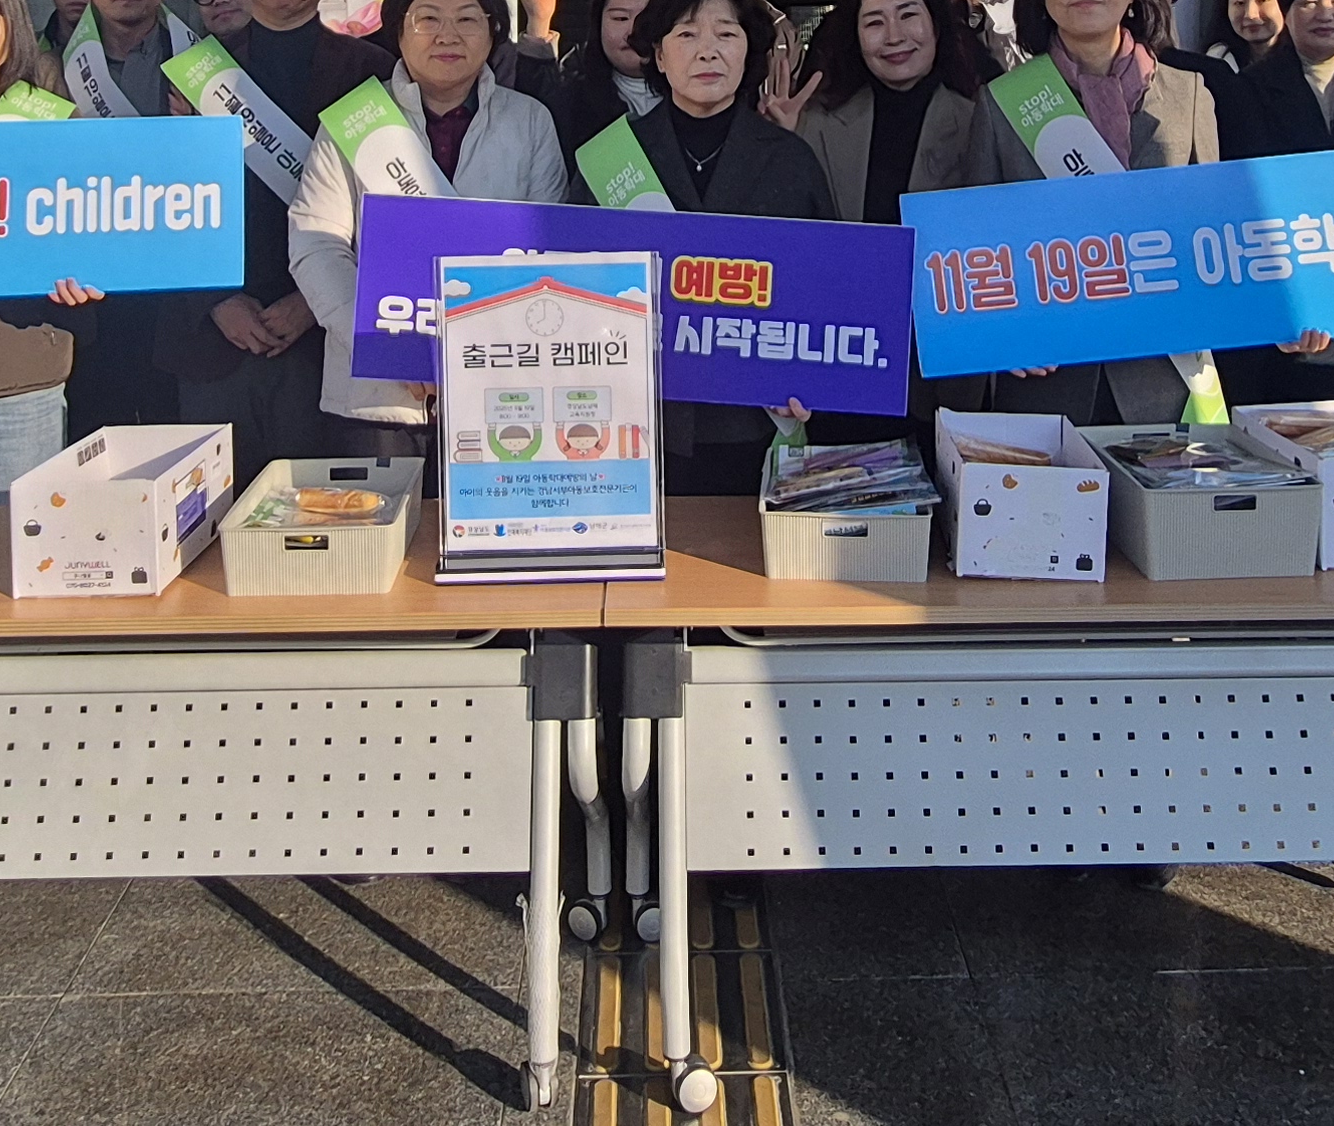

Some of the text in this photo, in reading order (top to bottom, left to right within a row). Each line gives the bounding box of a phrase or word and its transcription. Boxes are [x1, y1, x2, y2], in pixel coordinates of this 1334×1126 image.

[343, 100, 377, 128] stop!
[1018, 84, 1053, 115] stop!
[1021, 93, 1065, 127] 아동학대
[606, 161, 636, 194] stop!
[25, 175, 222, 236] children
[671, 255, 773, 307] 예방!
[925, 245, 1018, 314] 11월
[1027, 229, 1179, 305] 19일은
[462, 340, 629, 369] 출근길 캠페인
[673, 315, 890, 368] 시작됩니다.
